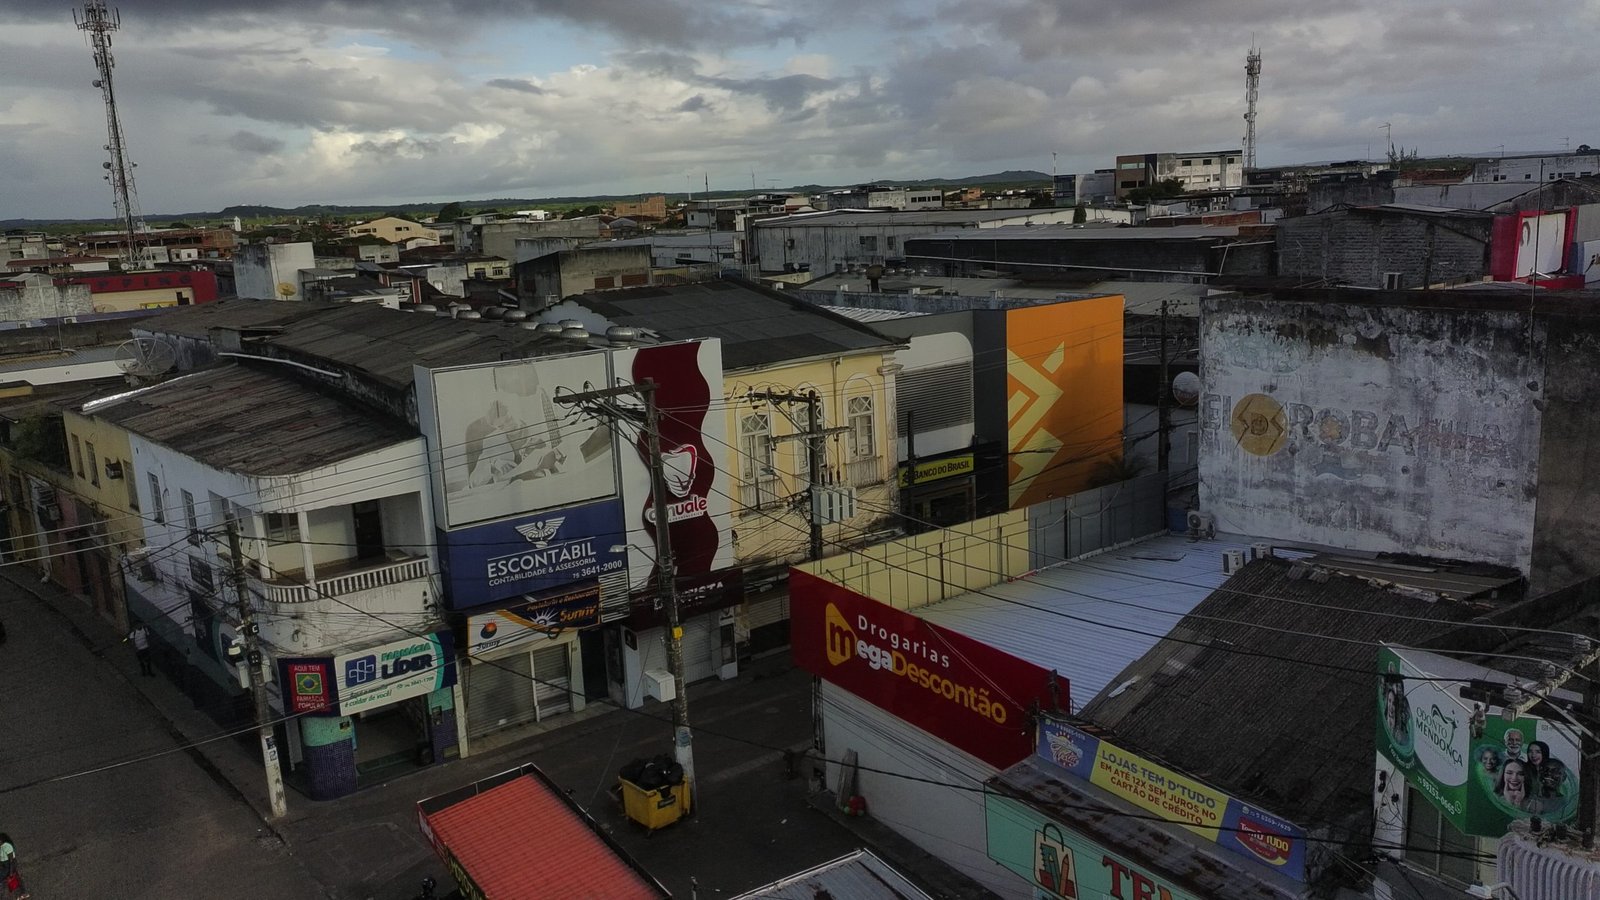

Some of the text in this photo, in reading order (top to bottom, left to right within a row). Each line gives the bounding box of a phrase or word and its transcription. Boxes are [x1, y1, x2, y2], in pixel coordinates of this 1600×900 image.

[913, 461, 971, 480] BANCO DO BRASIL
[487, 542, 597, 578] ESCONTÁBIL
[488, 557, 597, 587] CONTABILIDADE & ASSESSORIA
[581, 560, 623, 577] 3641-2000
[381, 642, 432, 662] FARMÁCIA
[857, 614, 951, 669] Drogarias
[294, 664, 321, 672] AQUI TEM
[381, 653, 433, 680] LÍDER
[296, 694, 325, 703] FARMÁCIA
[1416, 706, 1448, 739] ODONTO
[1415, 717, 1463, 767] MENDONÇA
[1099, 761, 1217, 821] EM ATÉ 12X SEM JUROS NO
[1101, 749, 1216, 809] LOJAS TEM D'TUDO
[1110, 776, 1203, 825] CARTÃO DE CRÉDITO
